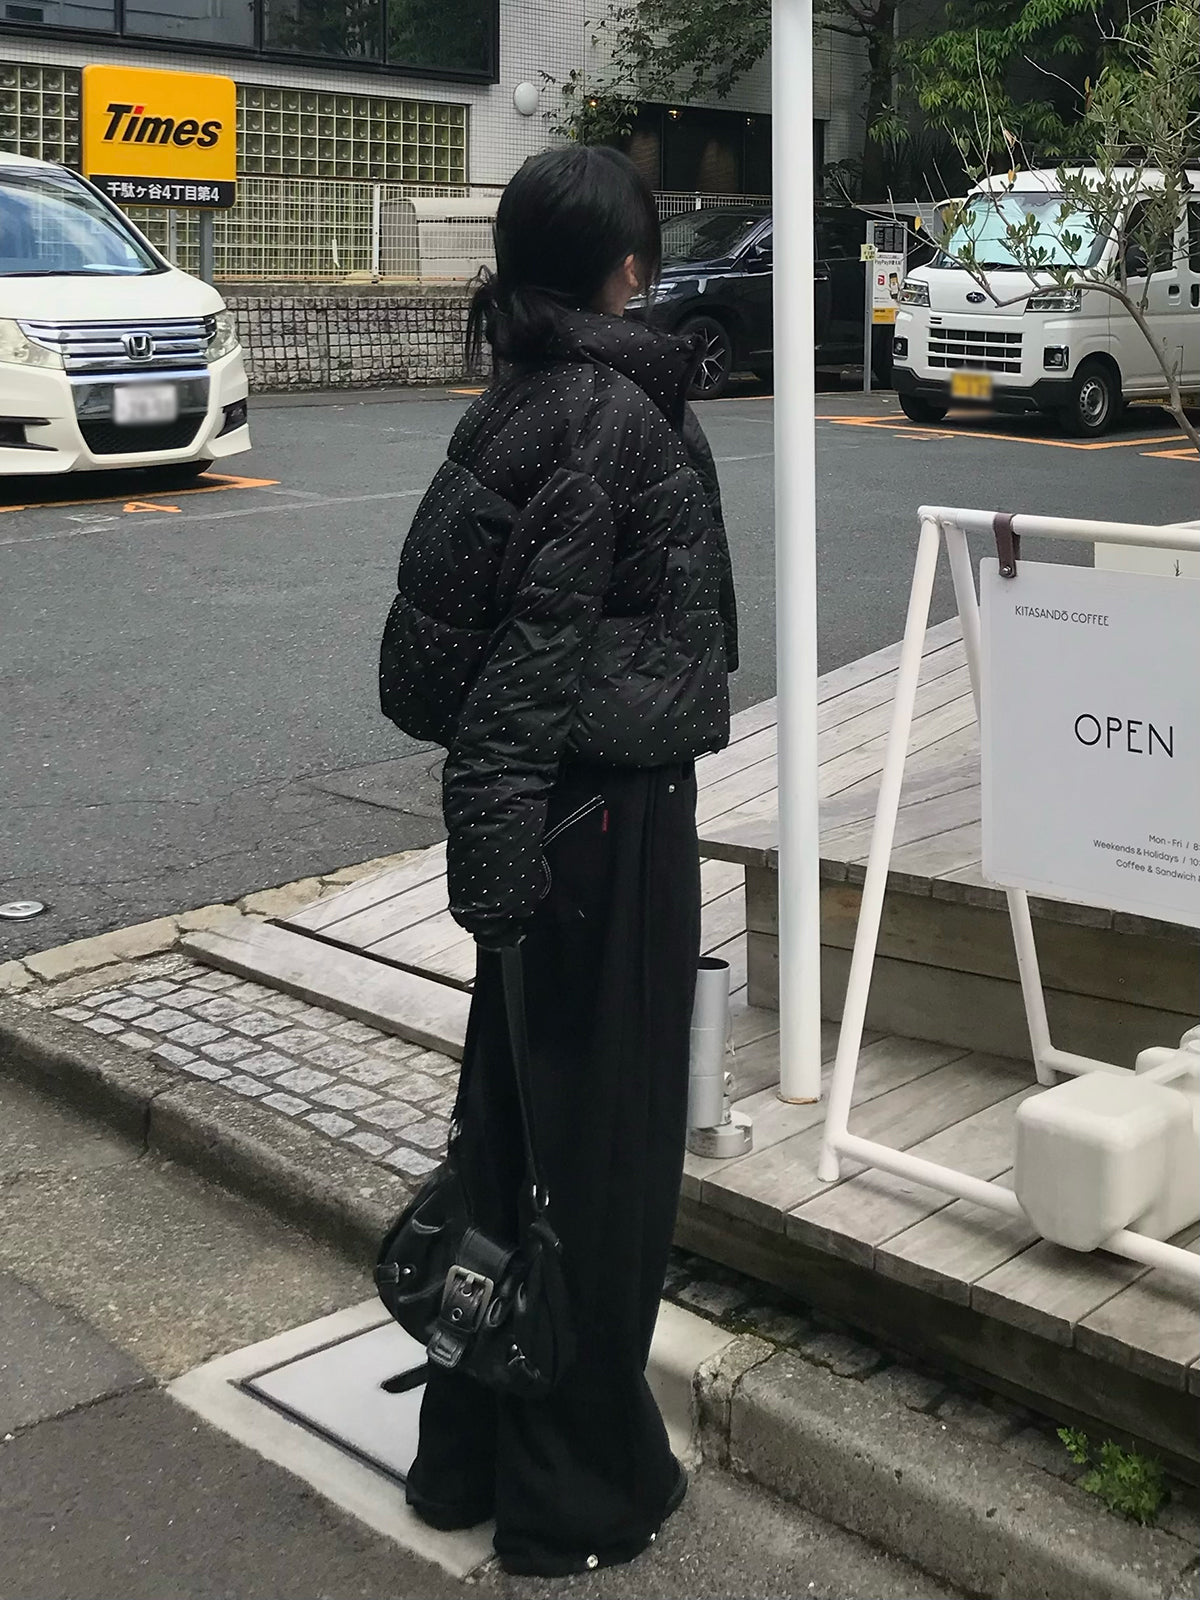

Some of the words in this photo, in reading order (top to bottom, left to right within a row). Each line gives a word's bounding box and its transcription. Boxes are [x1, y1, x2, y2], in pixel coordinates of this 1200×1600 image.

[103, 103, 222, 148] Times
[1071, 612, 1109, 627] COFFEE
[1074, 713, 1174, 758] OPEN
[1093, 840, 1135, 855] Weekends
[1136, 847, 1142, 856] &
[1143, 848, 1179, 864] Holidays
[1116, 858, 1145, 872] Coffee
[1147, 865, 1153, 873] &
[1155, 866, 1196, 882] Sandwich
